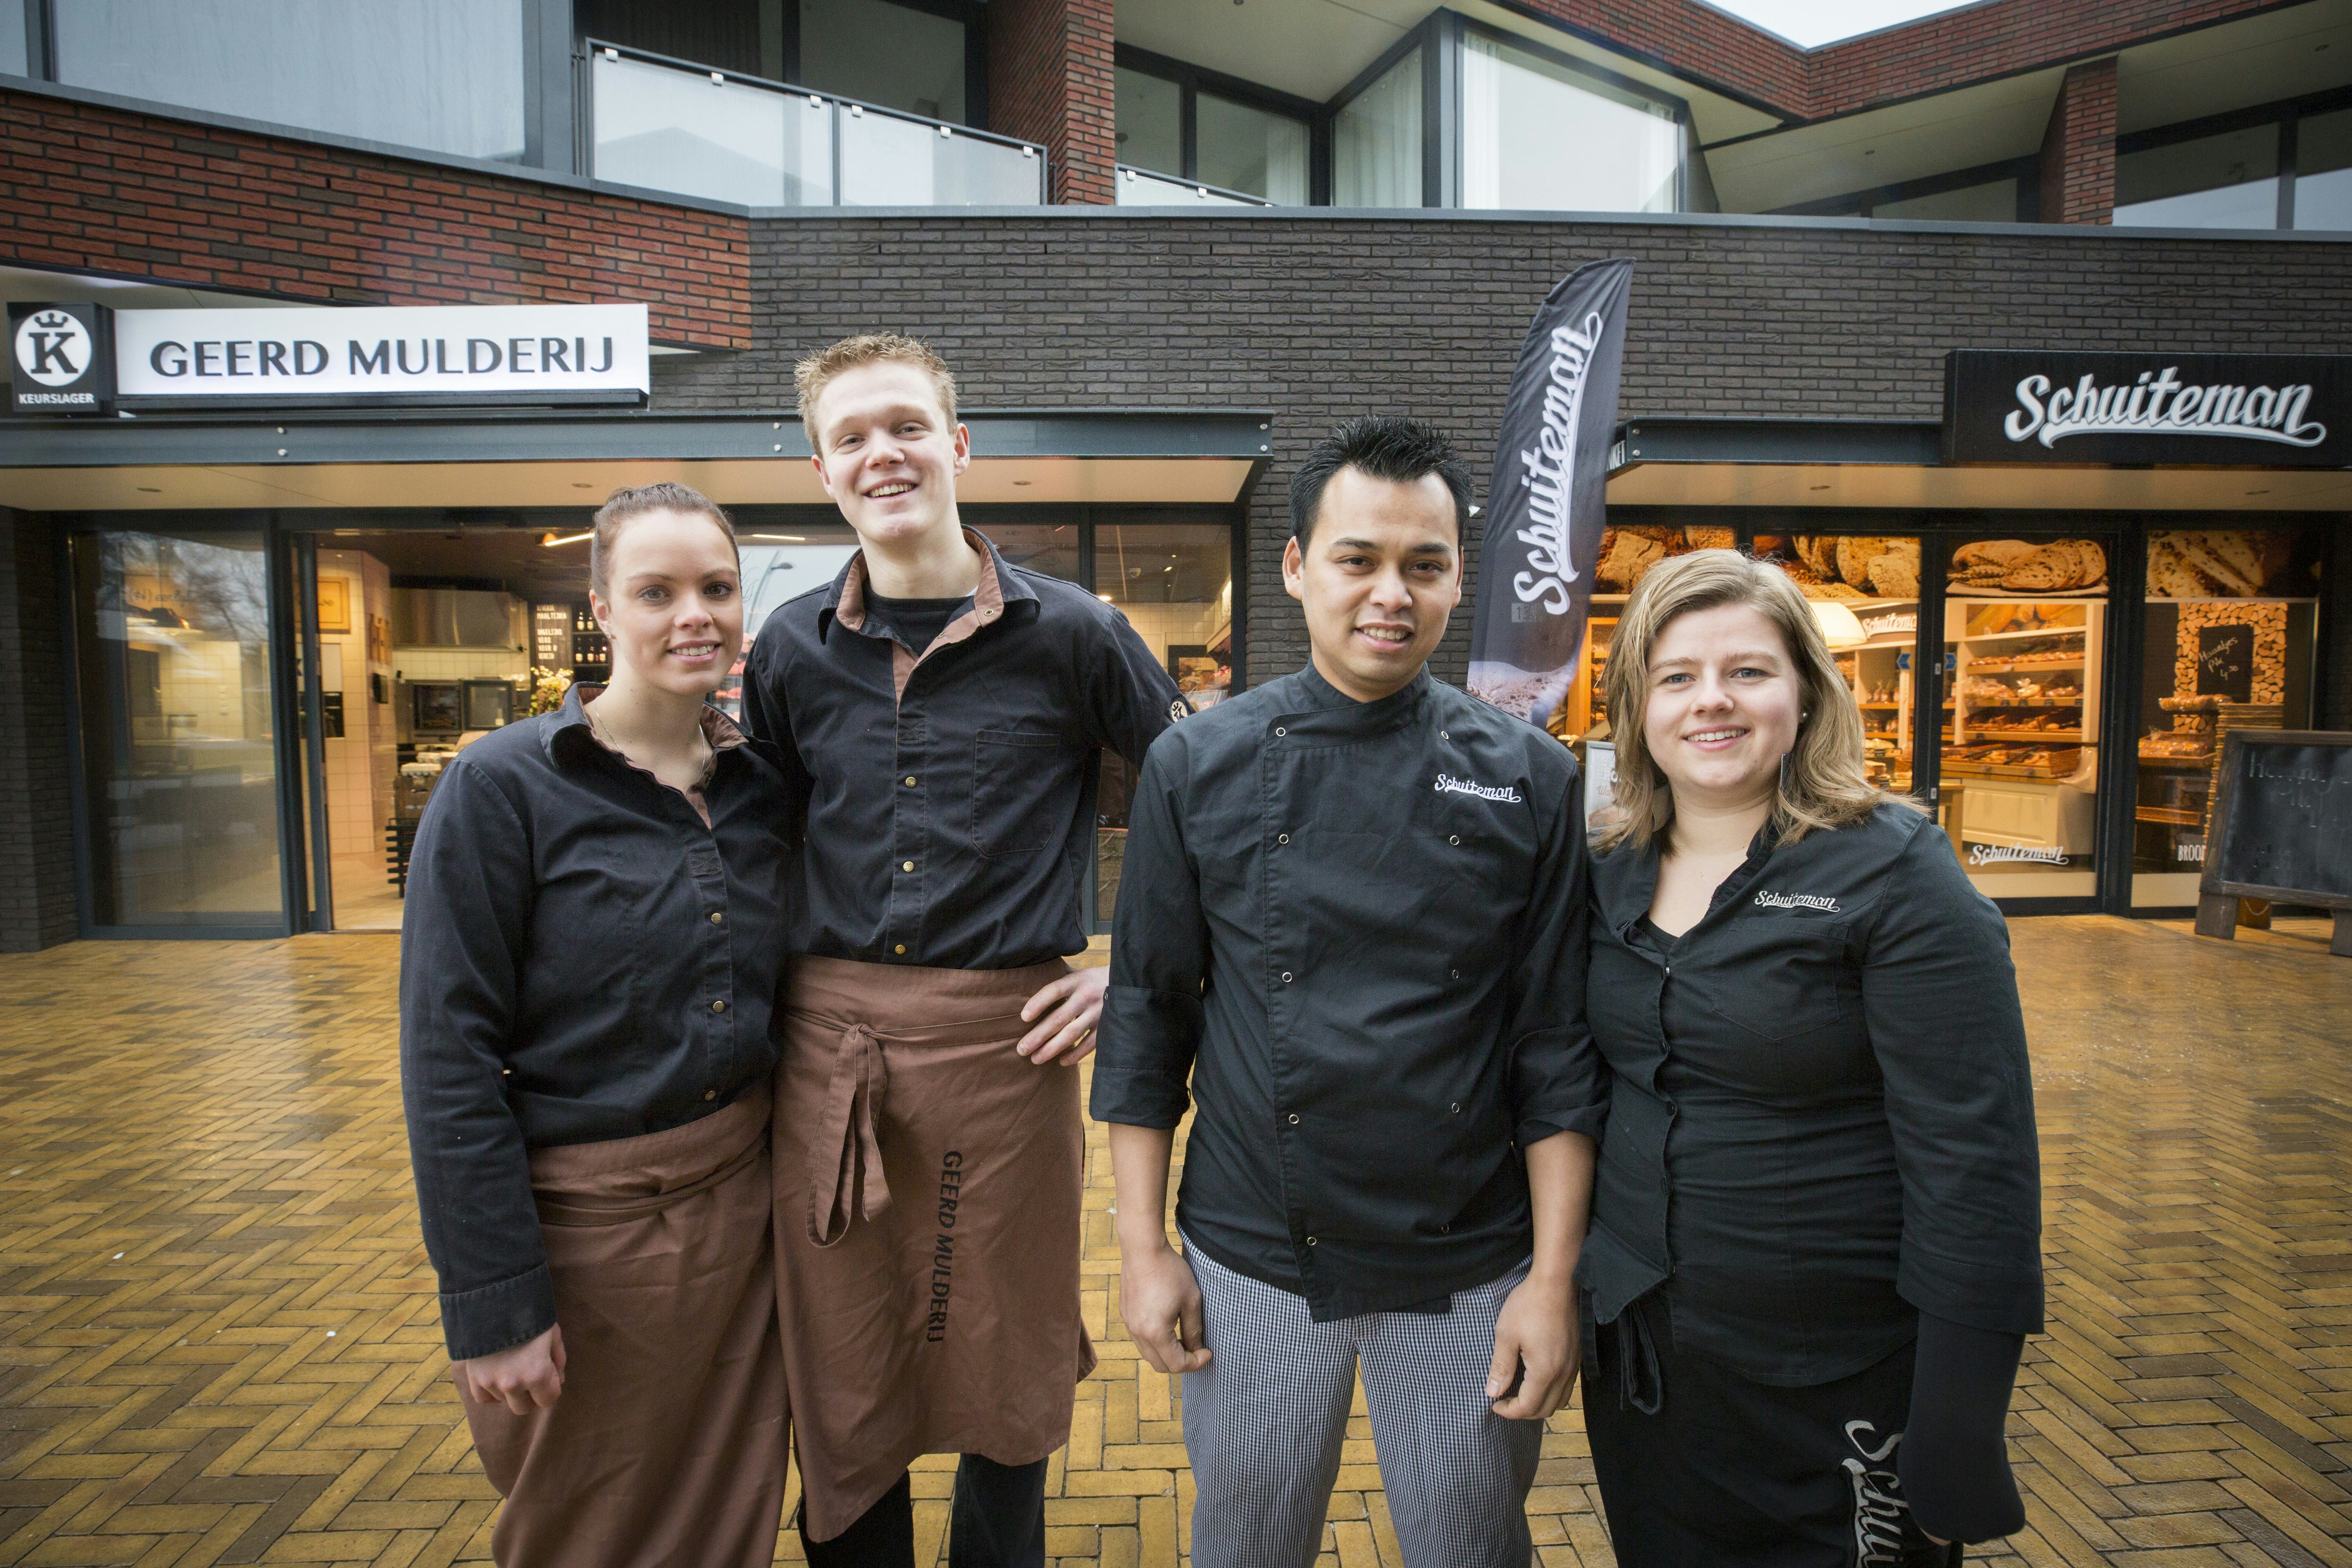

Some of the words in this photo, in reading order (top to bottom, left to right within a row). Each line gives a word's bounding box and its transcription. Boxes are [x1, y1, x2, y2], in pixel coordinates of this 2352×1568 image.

[28, 332, 79, 374] K
[150, 340, 329, 377] GEERD
[349, 337, 614, 375] MULDERIJ
[19, 393, 95, 404] KEURSLAGER
[2005, 366, 2327, 449] Schuiteman
[1513, 311, 1603, 615] Schuiteman
[1862, 612, 1917, 638] Schuitema
[1434, 774, 1521, 803] Schuiteman
[1968, 842, 2069, 867] Schuiteman
[1755, 891, 1841, 912] Schuiteman
[938, 1151, 963, 1230] GEERD
[927, 1233, 954, 1343] MULDERIJ
